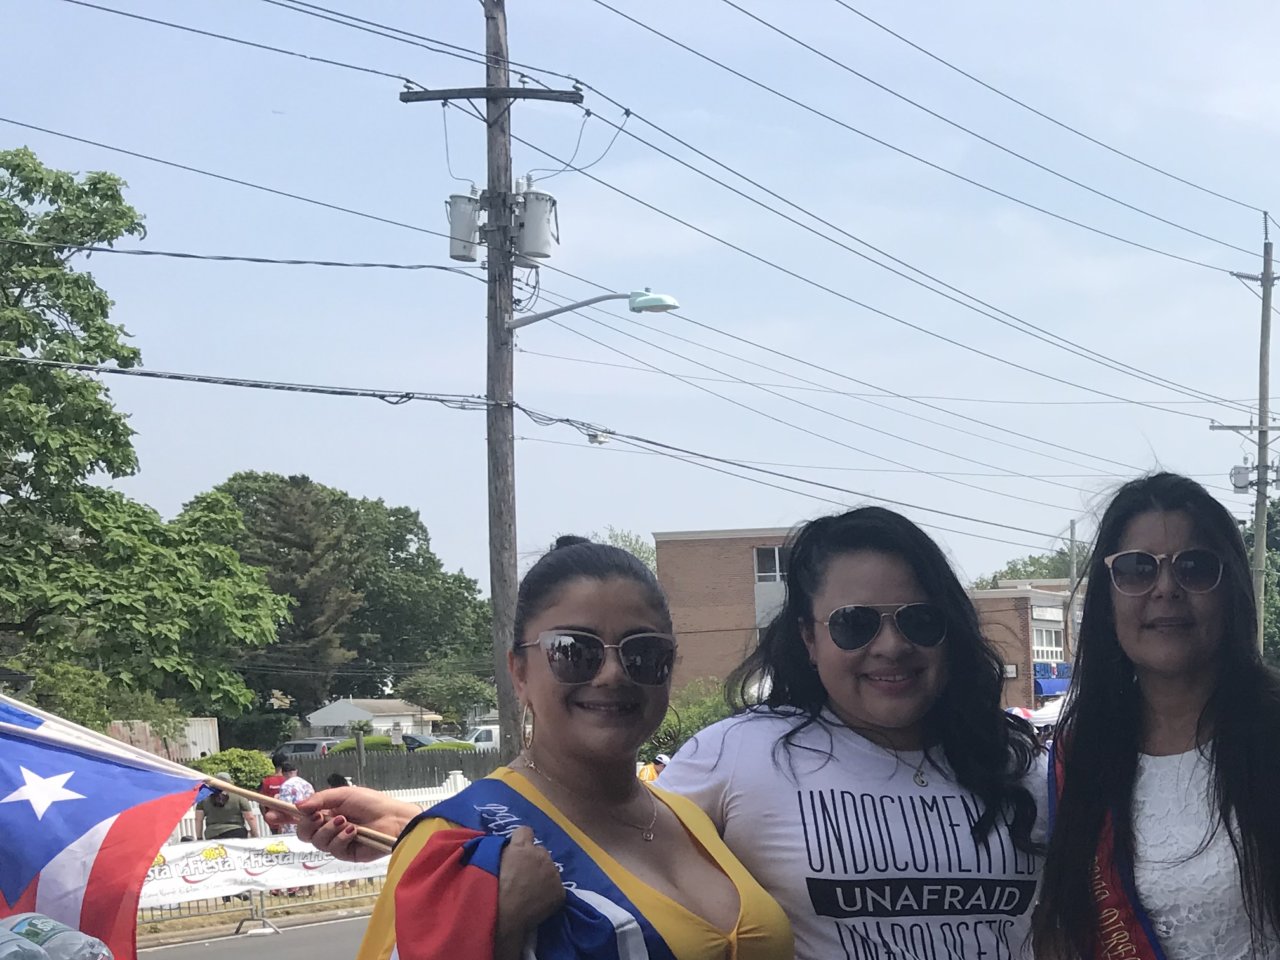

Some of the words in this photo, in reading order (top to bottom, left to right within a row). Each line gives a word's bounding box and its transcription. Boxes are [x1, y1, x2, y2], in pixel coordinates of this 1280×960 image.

[146, 864, 172, 880] sta
[187, 856, 236, 876] Fiesta
[836, 885, 1021, 912] UNAFRAID
